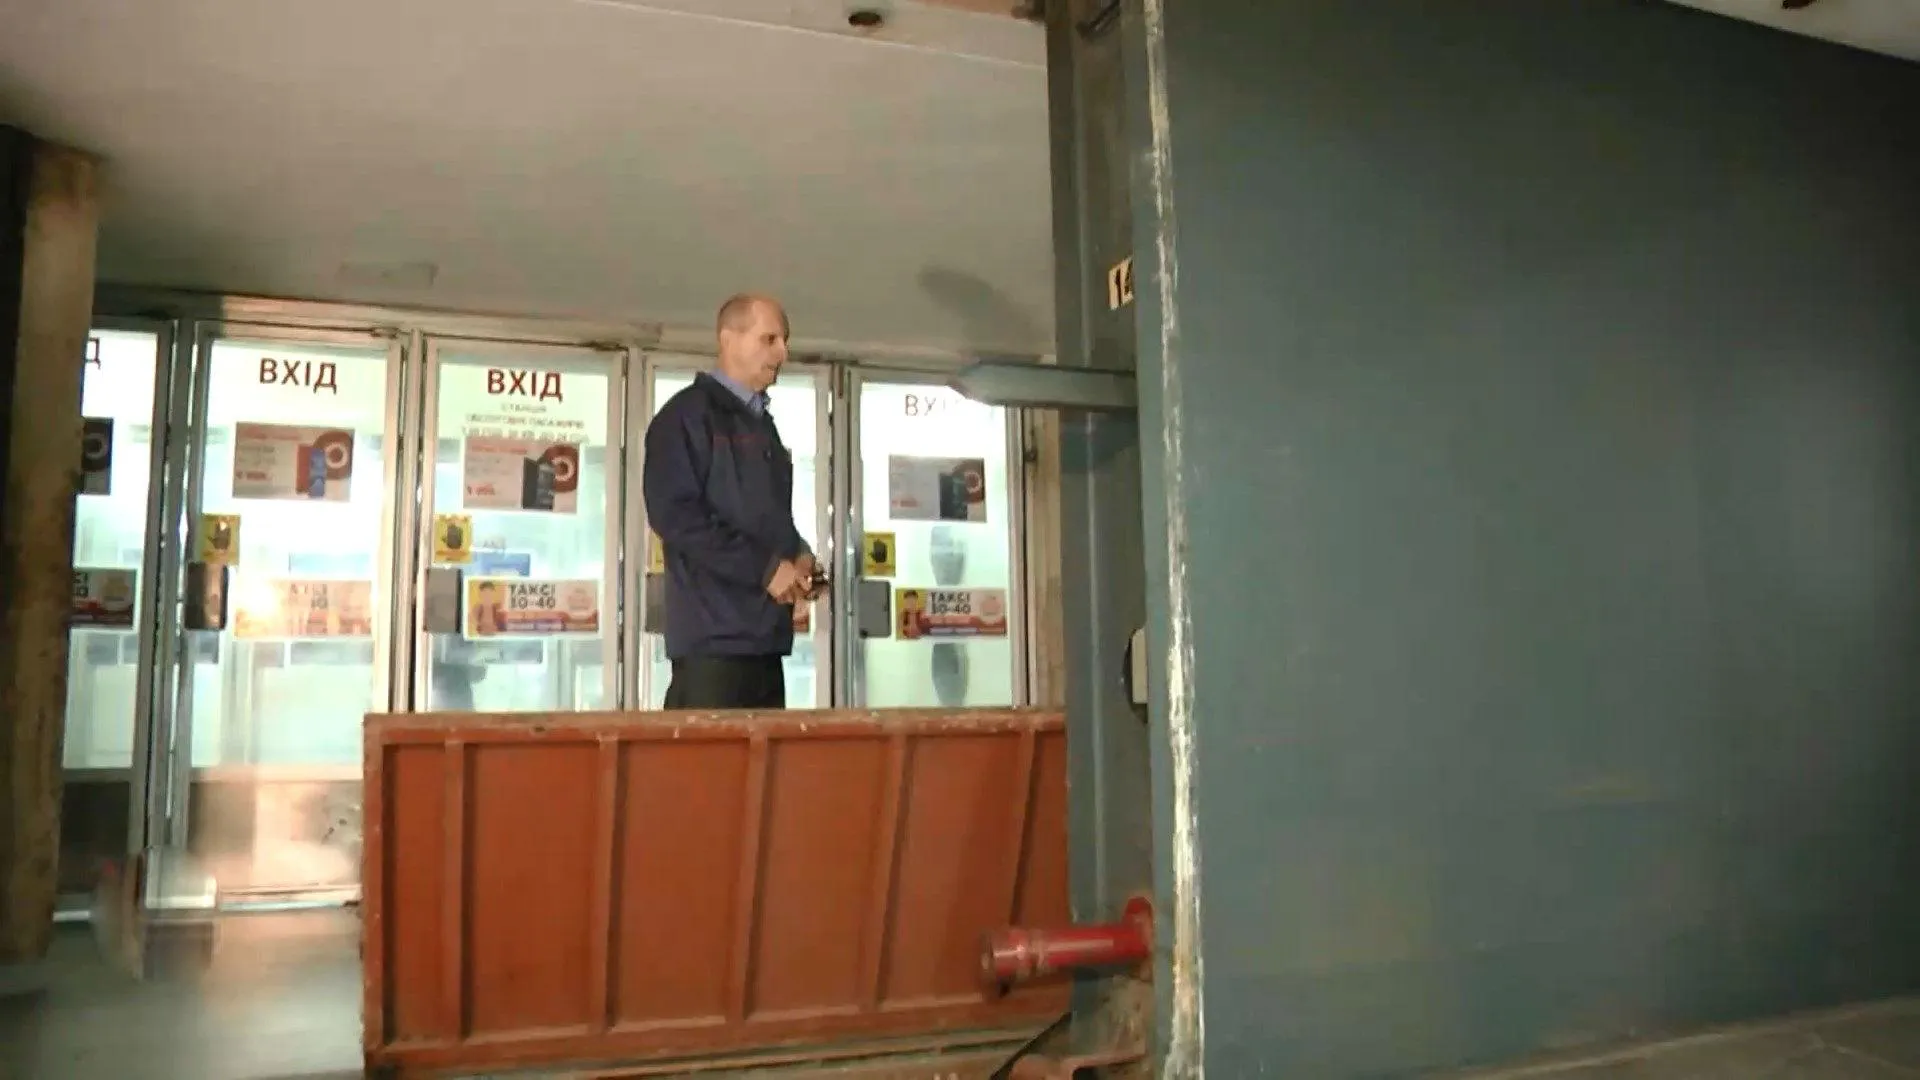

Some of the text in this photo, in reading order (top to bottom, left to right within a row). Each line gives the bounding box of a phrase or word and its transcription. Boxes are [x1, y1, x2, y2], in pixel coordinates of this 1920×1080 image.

[259, 357, 337, 395] ВХІД
[486, 368, 563, 403] ВХІД
[508, 583, 556, 597] ТАКСІ
